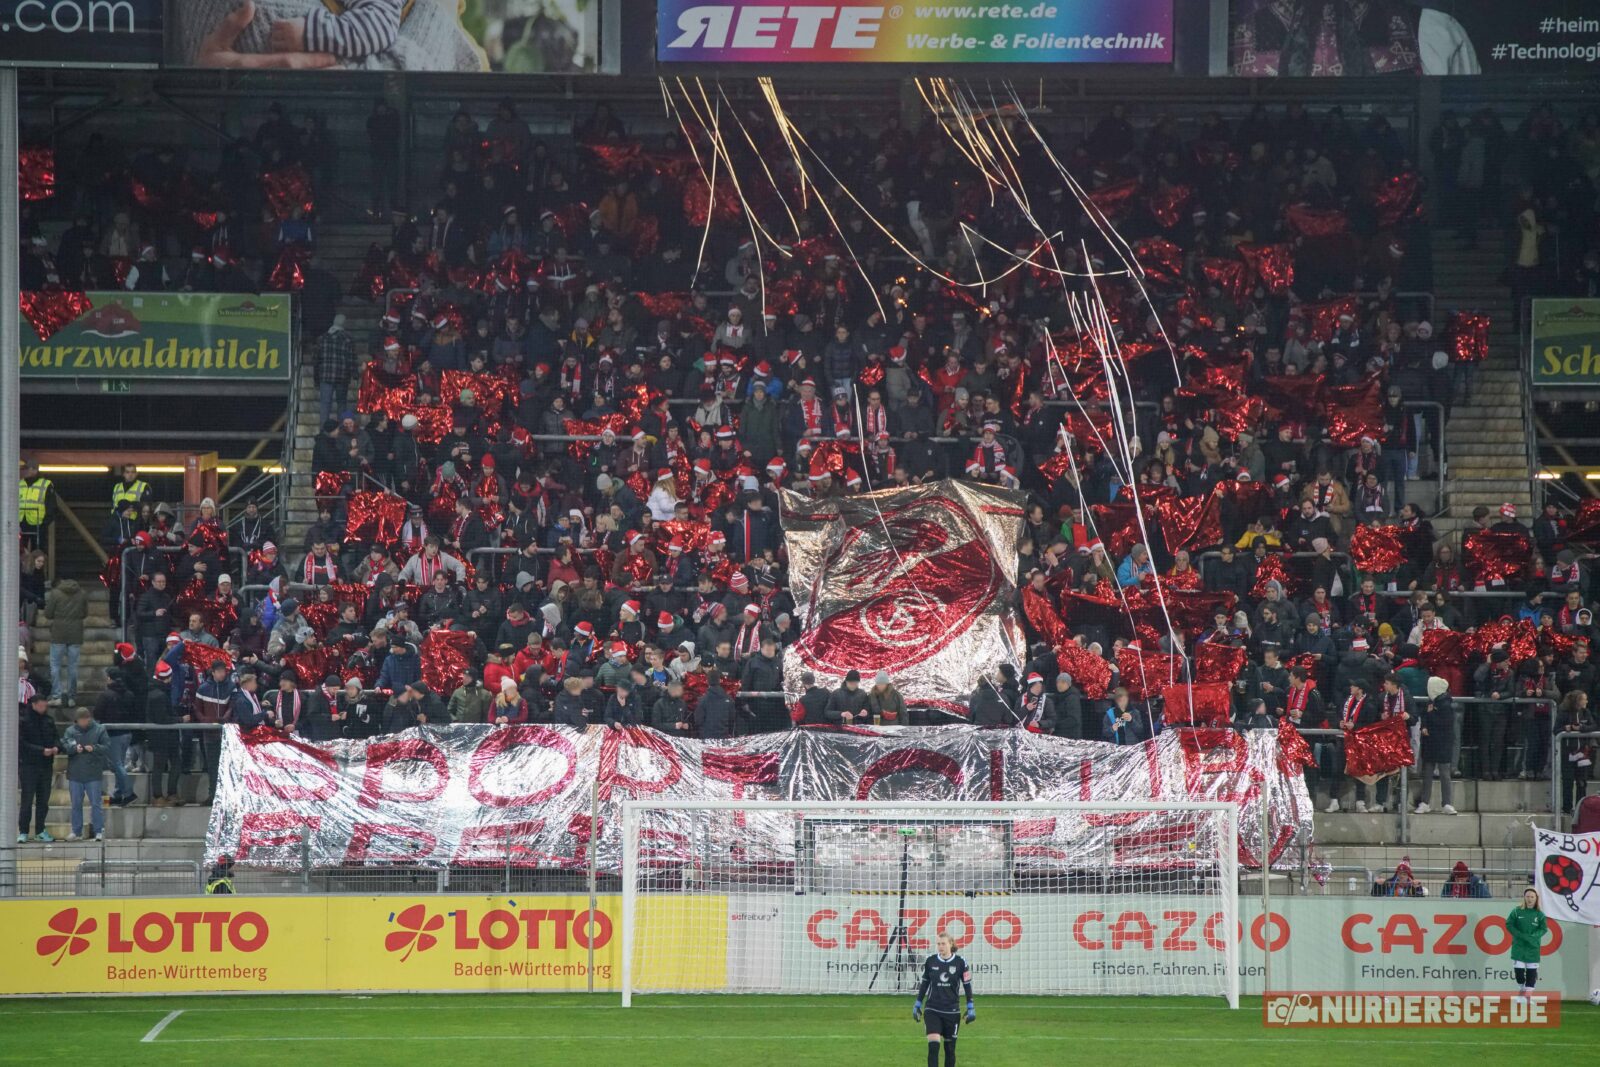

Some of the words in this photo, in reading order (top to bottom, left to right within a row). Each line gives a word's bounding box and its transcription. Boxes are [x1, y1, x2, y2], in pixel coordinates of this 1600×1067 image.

[915, 3, 1057, 19] www.rete.de
[1539, 17, 1599, 33] #heim
[906, 33, 985, 49] Werbe-
[990, 34, 1007, 49] &
[1012, 33, 1165, 49] Folientechnik
[108, 911, 269, 953] LOTTO
[455, 909, 613, 950] LOTTO
[806, 909, 1022, 949] CAZOO
[1073, 911, 1290, 952] CAZOO
[107, 964, 268, 981] Baden-Württemberg
[454, 962, 612, 979] Baden-Württemberg
[1092, 962, 1149, 976] Finden.
[1153, 962, 1210, 976] Fahren.
[1361, 964, 1419, 980] Finden.
[1422, 965, 1481, 981] Fahren.
